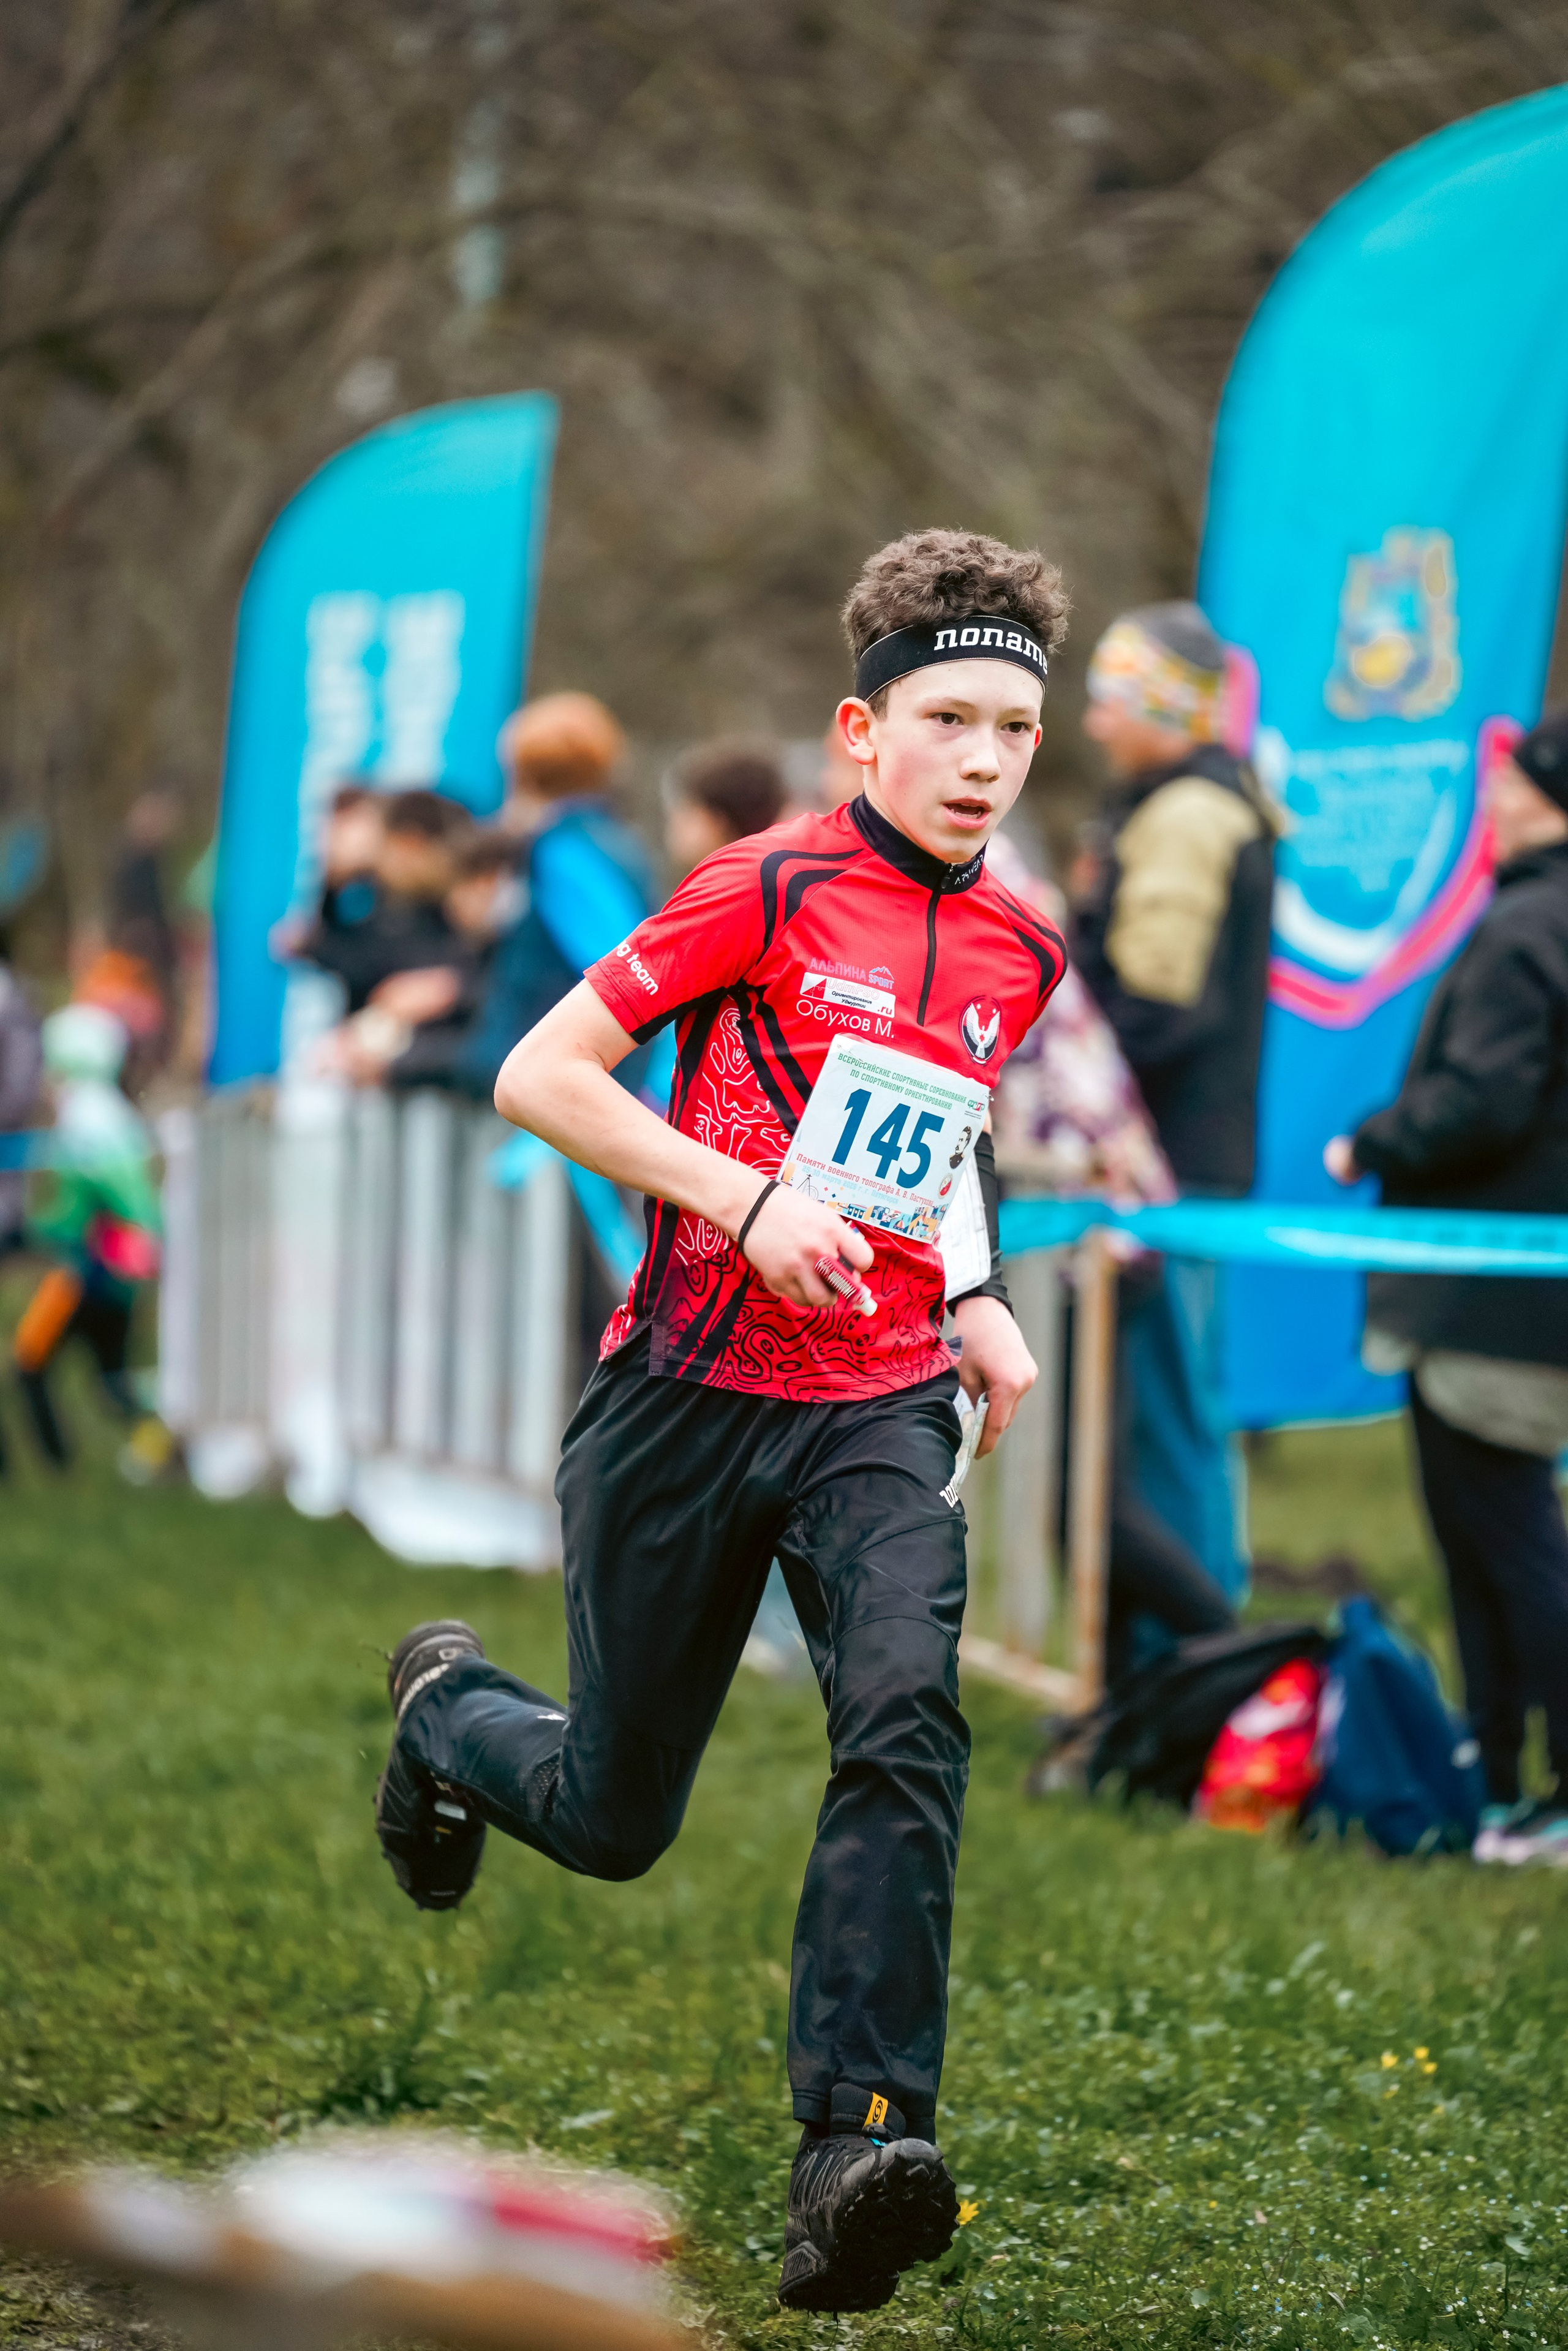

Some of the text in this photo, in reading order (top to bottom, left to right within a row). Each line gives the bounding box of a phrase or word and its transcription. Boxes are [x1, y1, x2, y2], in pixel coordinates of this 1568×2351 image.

[626, 953, 659, 996] team
[809, 957, 867, 982] АЛЬПИНА
[868, 973, 894, 990] SPORT
[826, 977, 880, 1000] UdmFSO
[831, 991, 872, 1005] Ориентирование
[841, 998, 866, 1009] Удмуртии
[796, 999, 894, 1039] Обухов М.
[877, 1006, 892, 1015] .ru
[837, 1052, 967, 1103] ВСЕРОССИЙСКИЕ СПОРТИВНЫЕ СОРЕВНОВАНИЯ
[850, 1069, 952, 1110] ПО СПОРТИВНОМУ ОРИЕНТИРОВАНИЮ
[831, 1088, 945, 1189] 145
[796, 1153, 826, 1171] Памяти
[827, 1166, 860, 1182] военного
[861, 1177, 894, 1194] топографа
